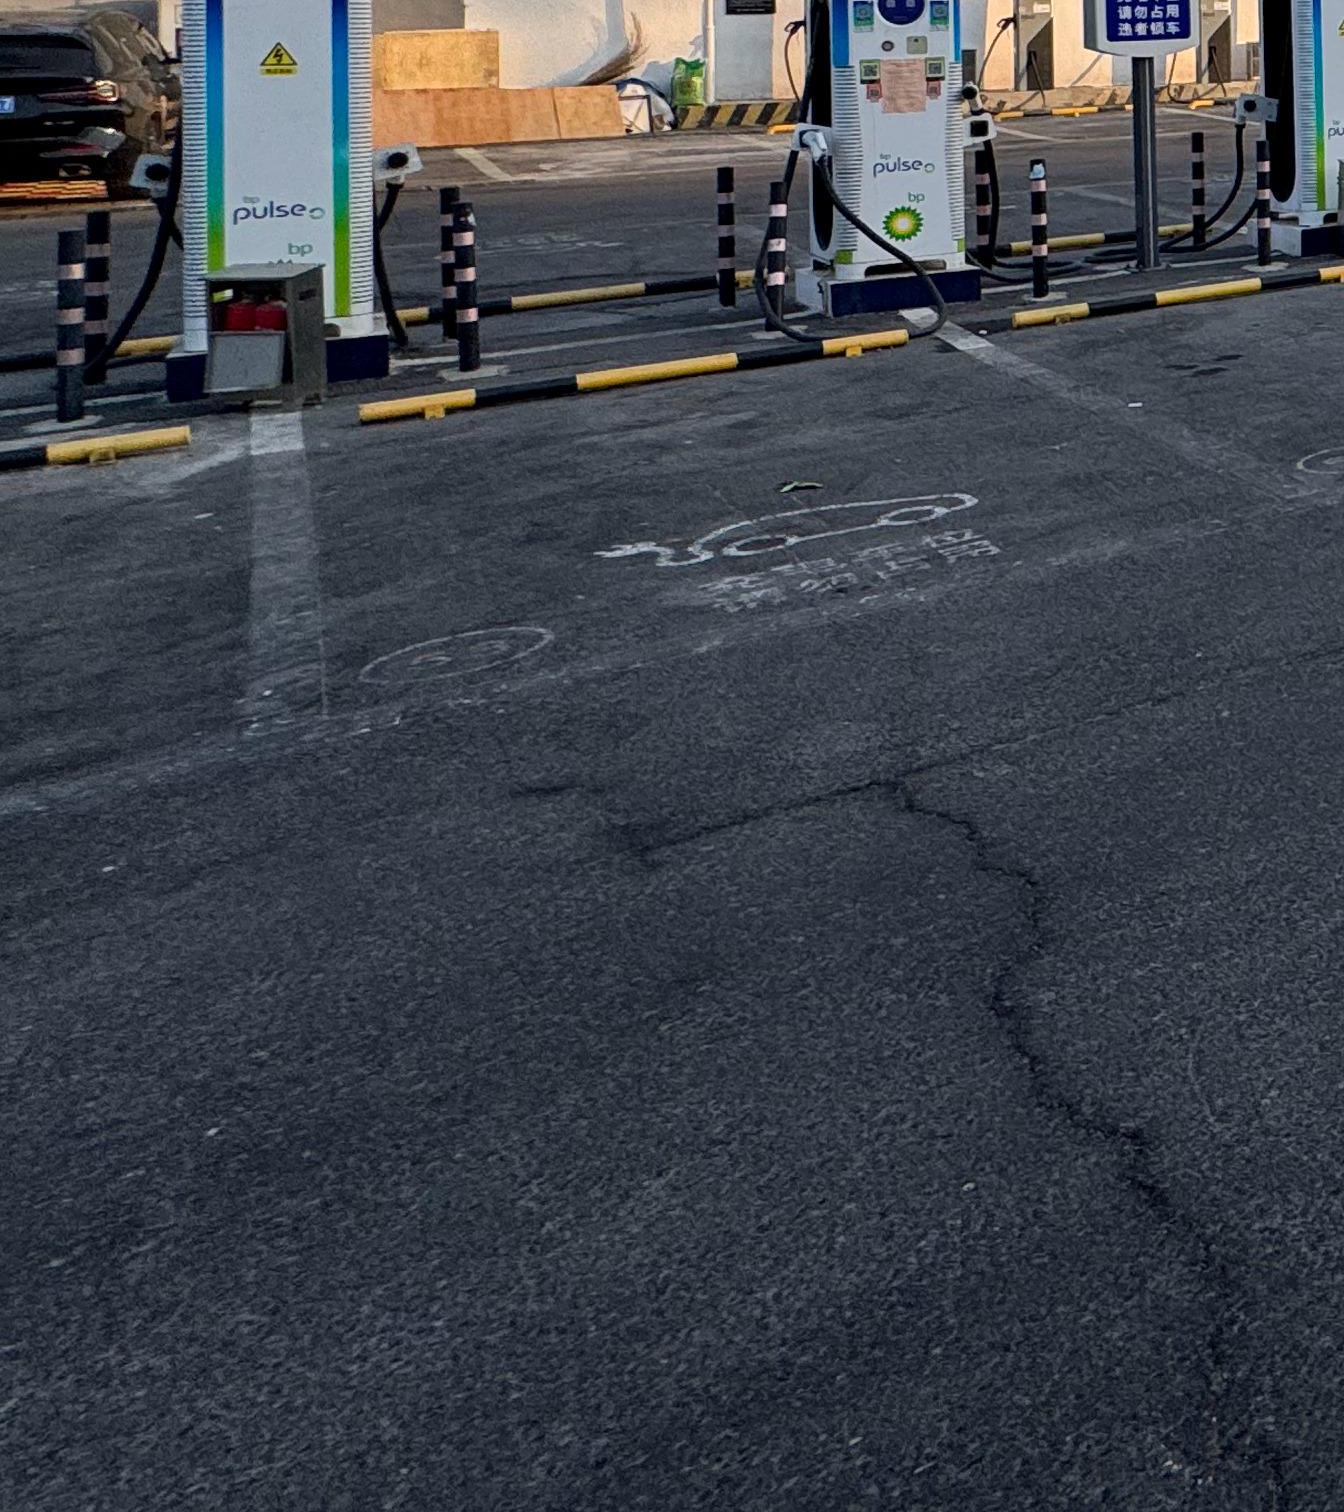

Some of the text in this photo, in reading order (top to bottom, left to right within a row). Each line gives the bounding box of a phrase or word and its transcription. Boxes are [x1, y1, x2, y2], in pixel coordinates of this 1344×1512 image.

[1117, 4, 1180, 19] 请勿占用
[872, 157, 923, 178] pulse
[907, 191, 926, 204] bp
[233, 201, 307, 225] pulse
[287, 242, 314, 258] bp
